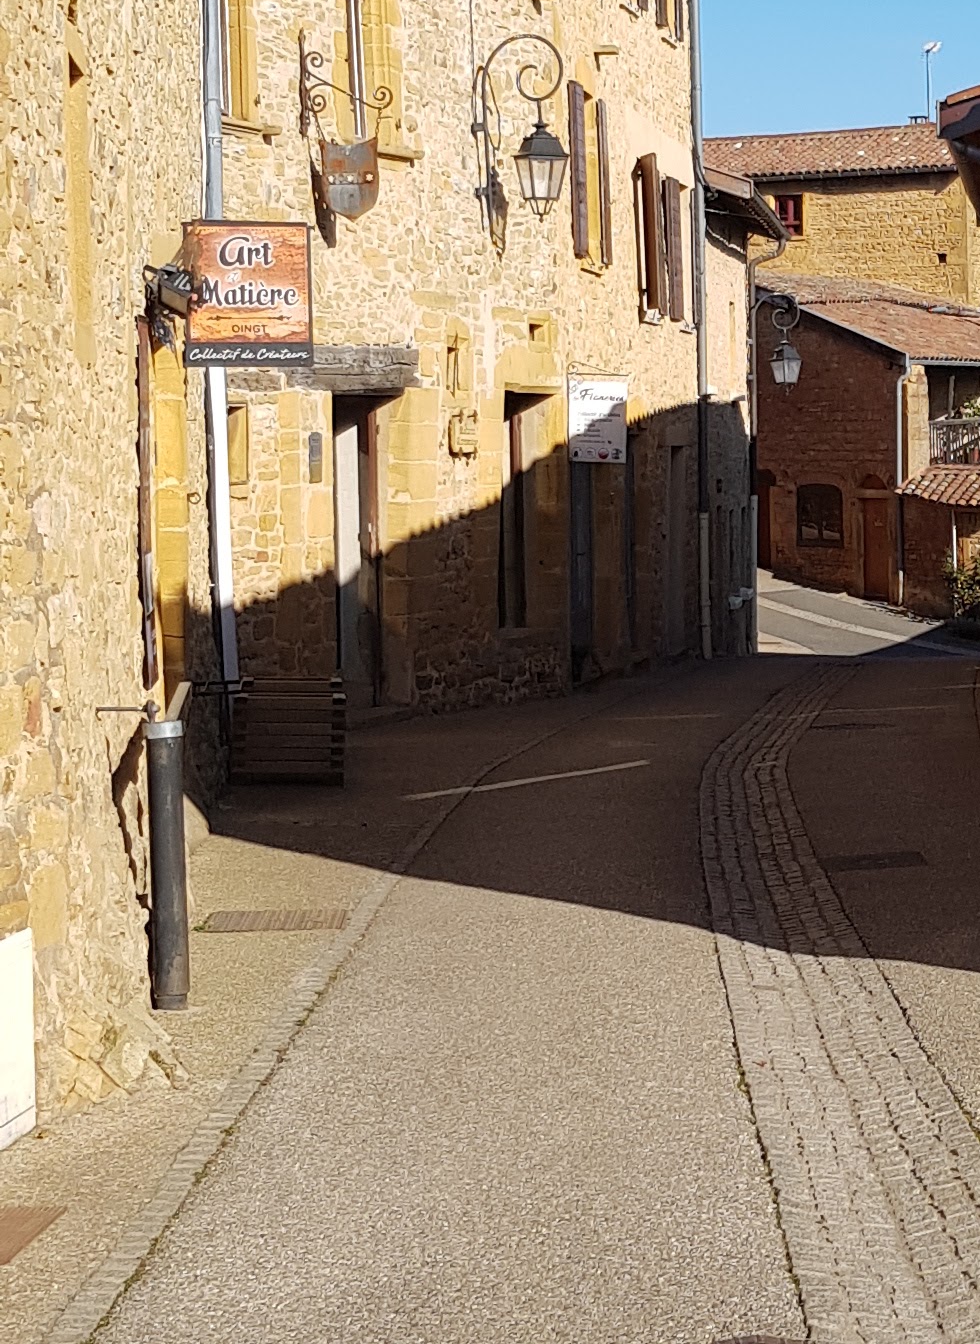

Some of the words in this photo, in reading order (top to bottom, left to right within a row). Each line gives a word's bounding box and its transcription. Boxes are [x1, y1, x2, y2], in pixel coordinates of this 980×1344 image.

[219, 236, 274, 267] Art
[202, 275, 299, 307] Matière
[231, 324, 267, 334] OINGT
[189, 347, 241, 361] Collectif
[241, 348, 255, 359] de
